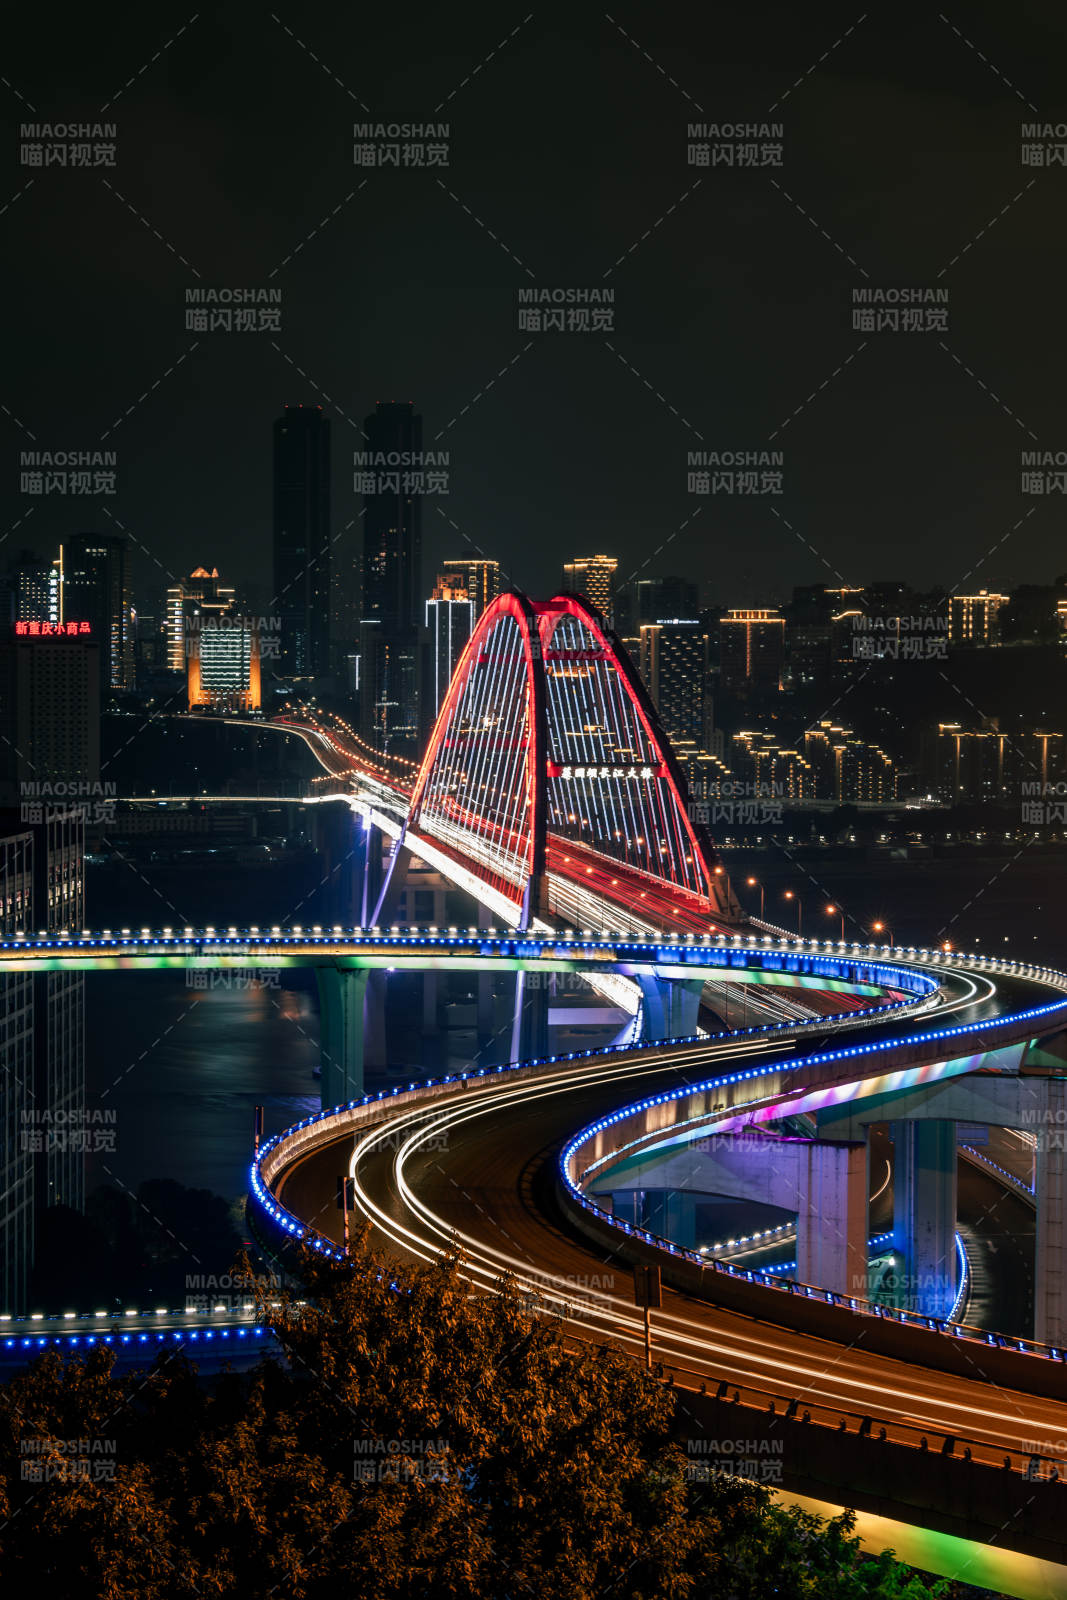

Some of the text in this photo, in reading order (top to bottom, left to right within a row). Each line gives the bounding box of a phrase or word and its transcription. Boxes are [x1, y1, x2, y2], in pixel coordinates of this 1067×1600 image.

[16, 621, 91, 635] 新重庆小商品
